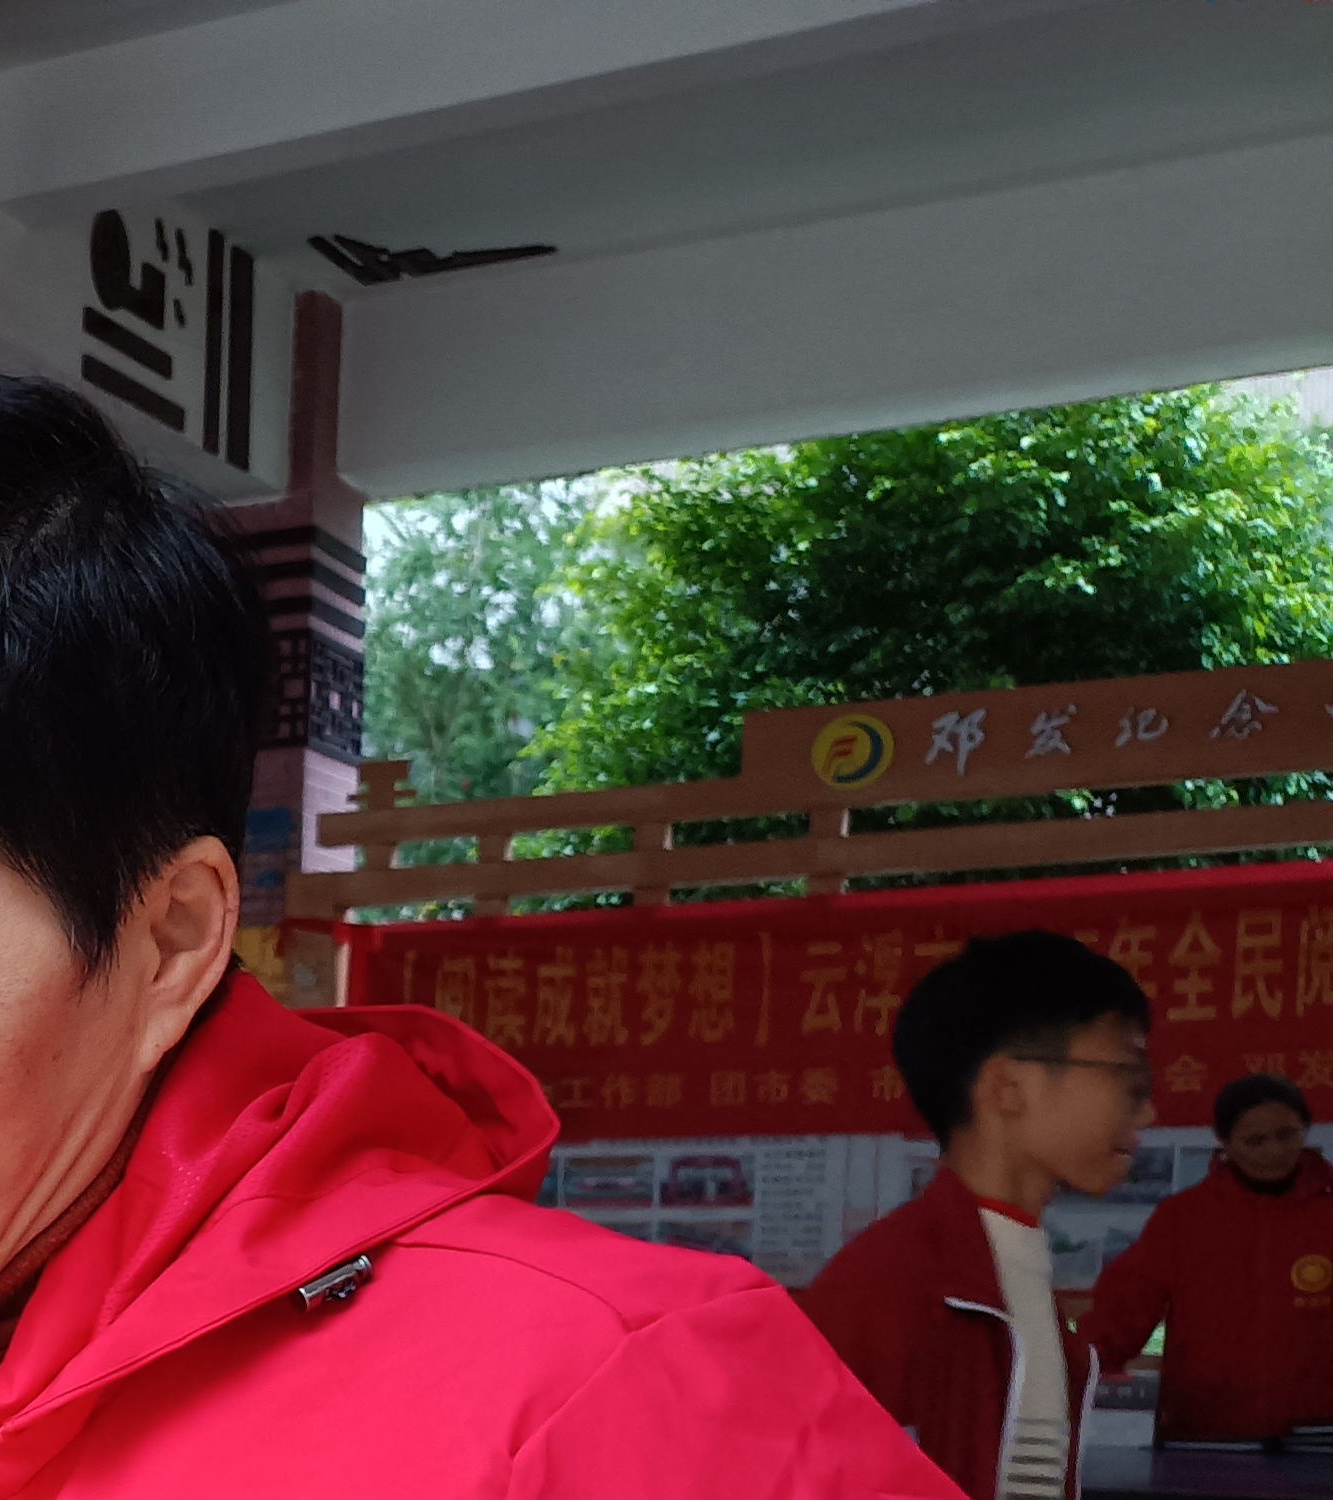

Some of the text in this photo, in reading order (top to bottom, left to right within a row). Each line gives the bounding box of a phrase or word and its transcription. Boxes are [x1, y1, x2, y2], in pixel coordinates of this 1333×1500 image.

[925, 688, 1333, 776] 邓发纪念
[538, 1070, 685, 1108] 工作部
